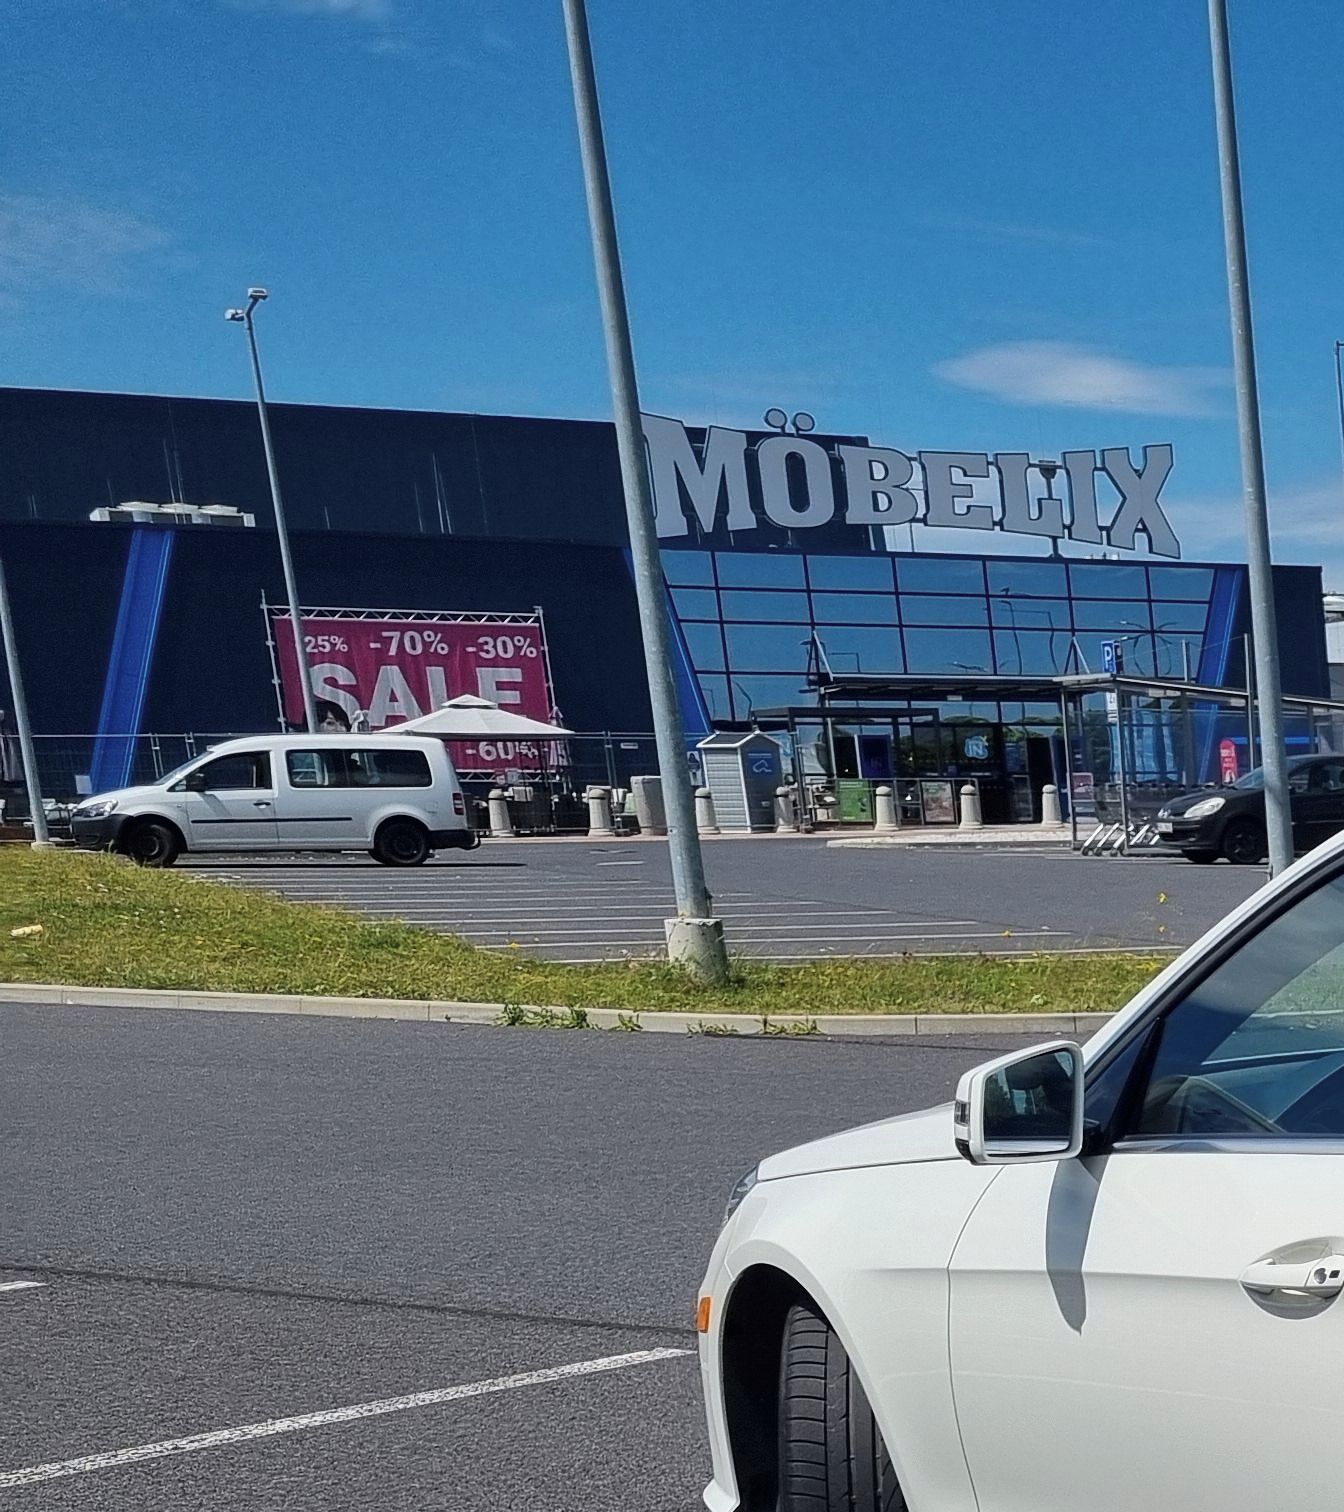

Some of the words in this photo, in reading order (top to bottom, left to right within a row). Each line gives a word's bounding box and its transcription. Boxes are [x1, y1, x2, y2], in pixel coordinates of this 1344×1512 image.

[640, 408, 1181, 559] MÖBELIX
[369, 630, 449, 656] -70%
[466, 636, 538, 659] -30%
